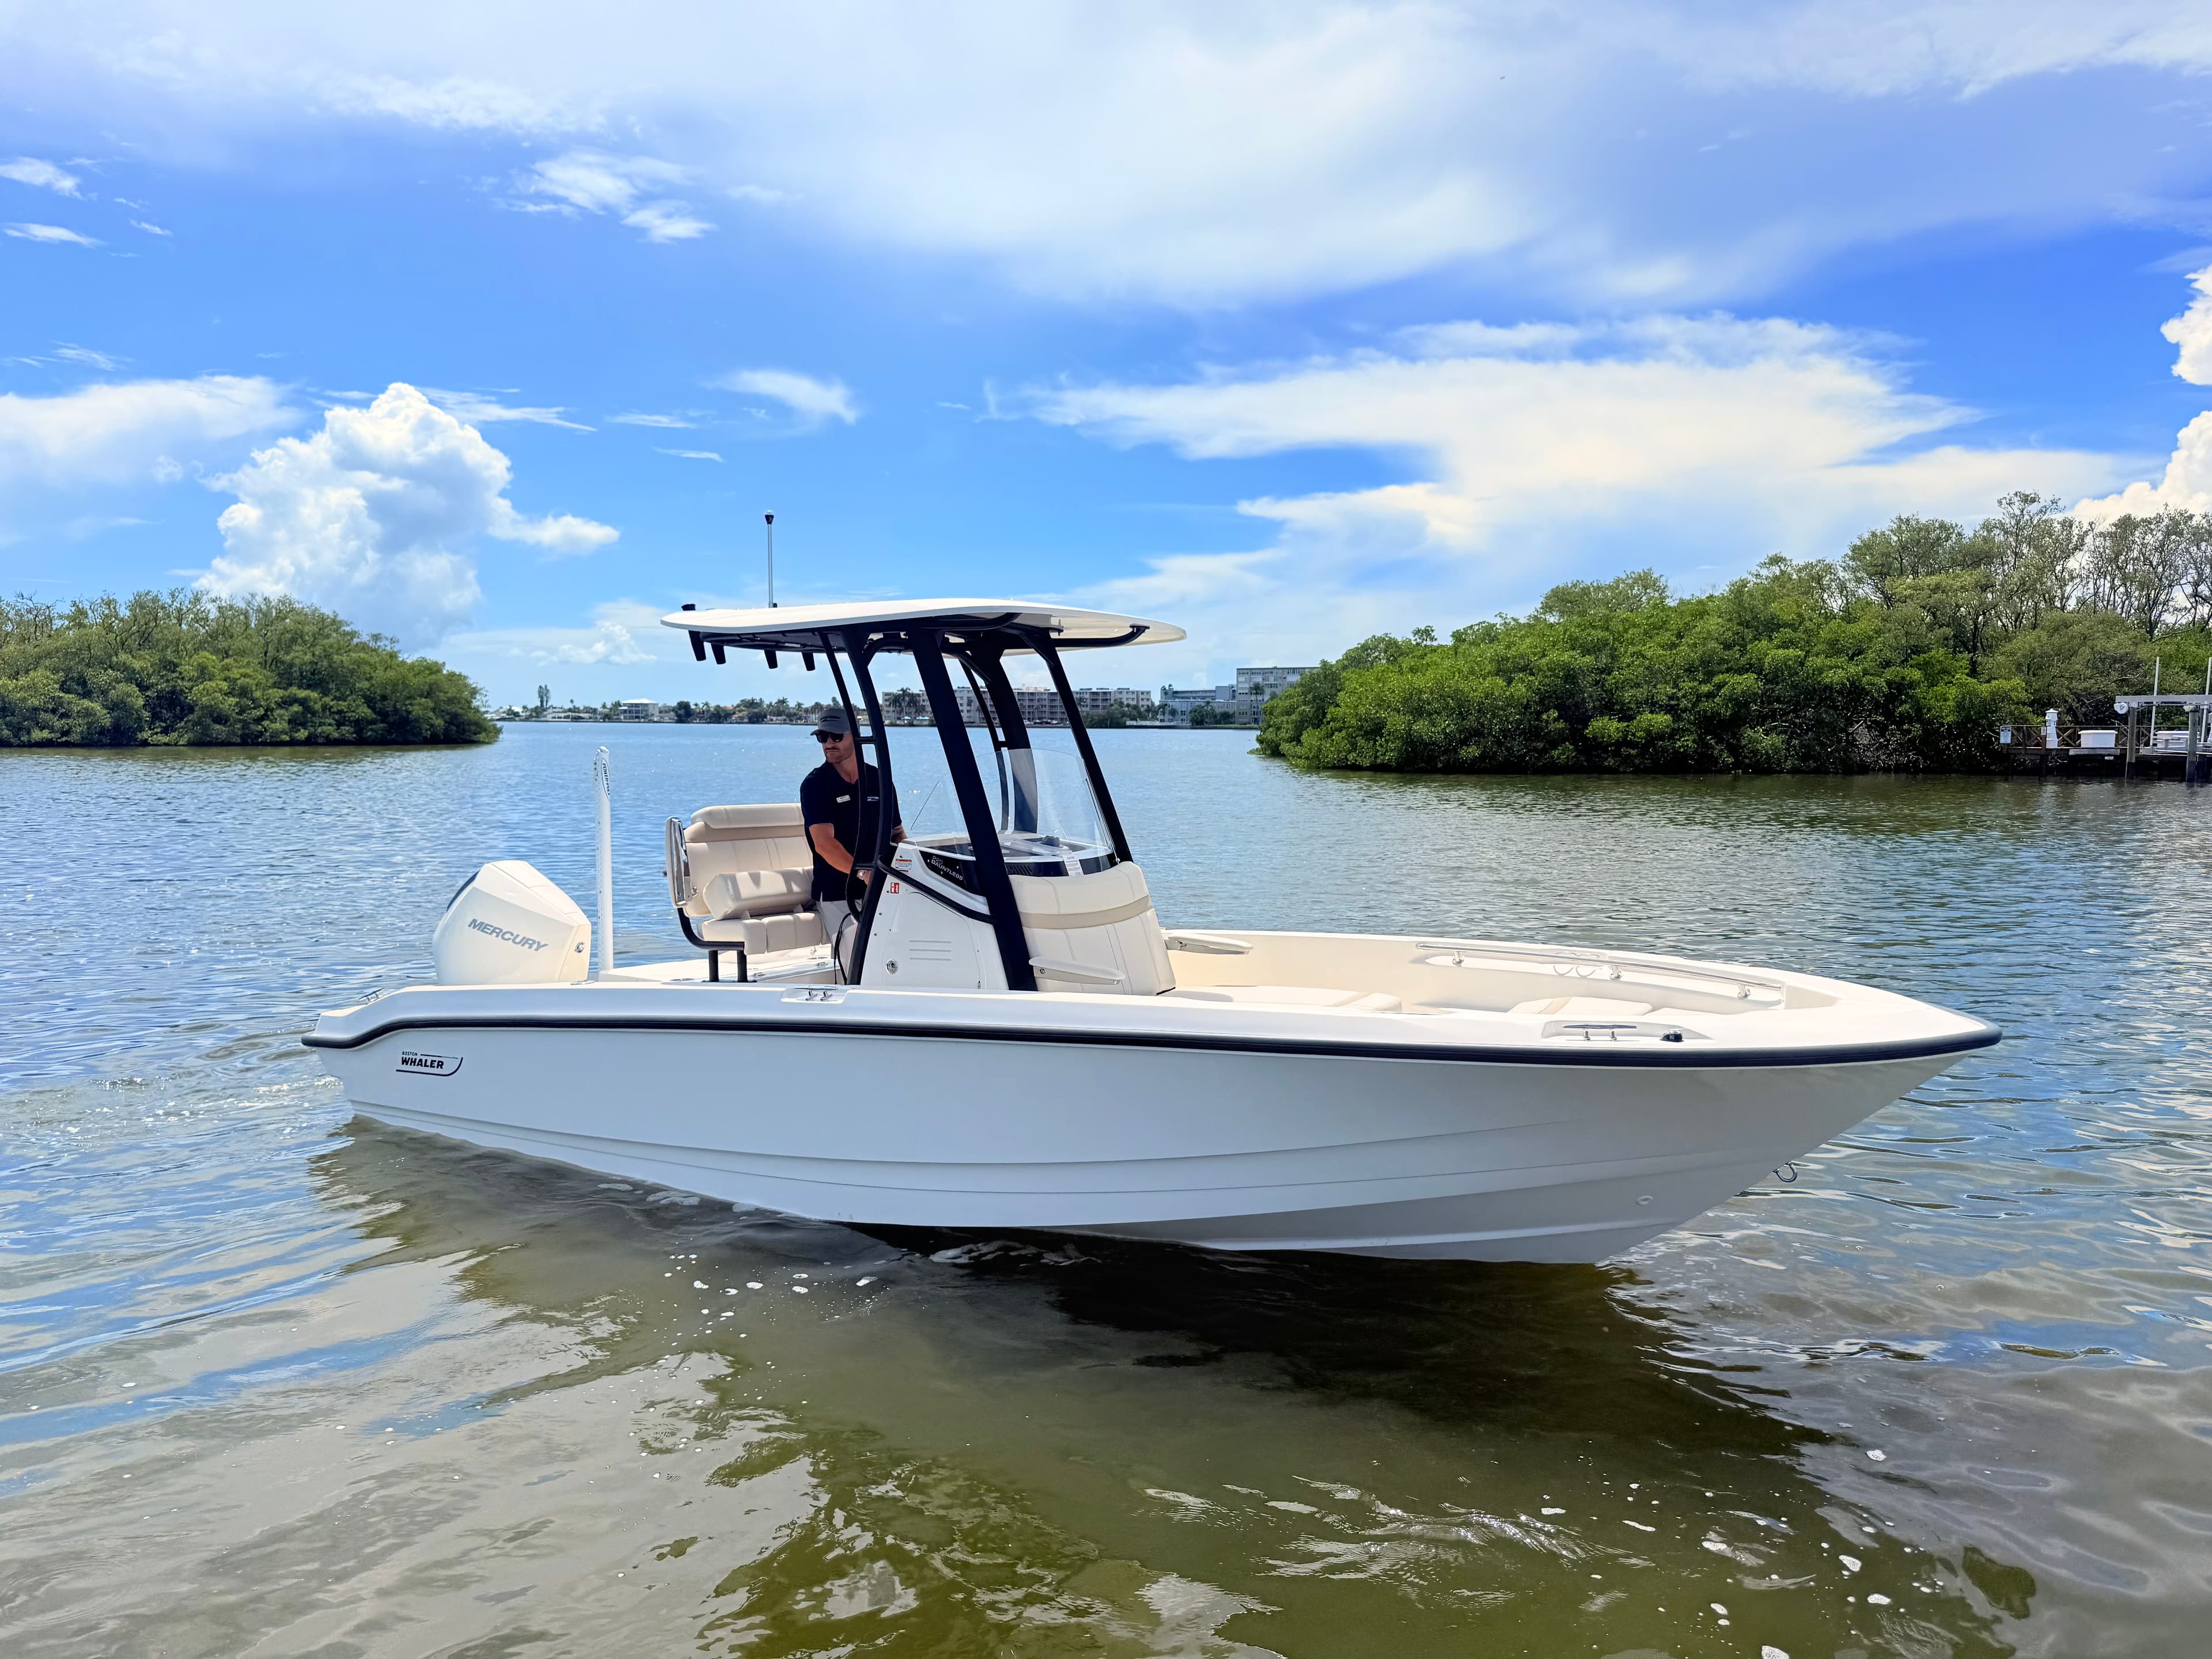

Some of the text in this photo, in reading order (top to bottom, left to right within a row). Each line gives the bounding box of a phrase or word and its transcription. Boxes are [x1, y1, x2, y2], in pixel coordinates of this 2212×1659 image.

[931, 860, 963, 881] DAUNTLESS
[468, 918, 549, 952] MERCURY
[401, 1056, 444, 1069] WHALER
